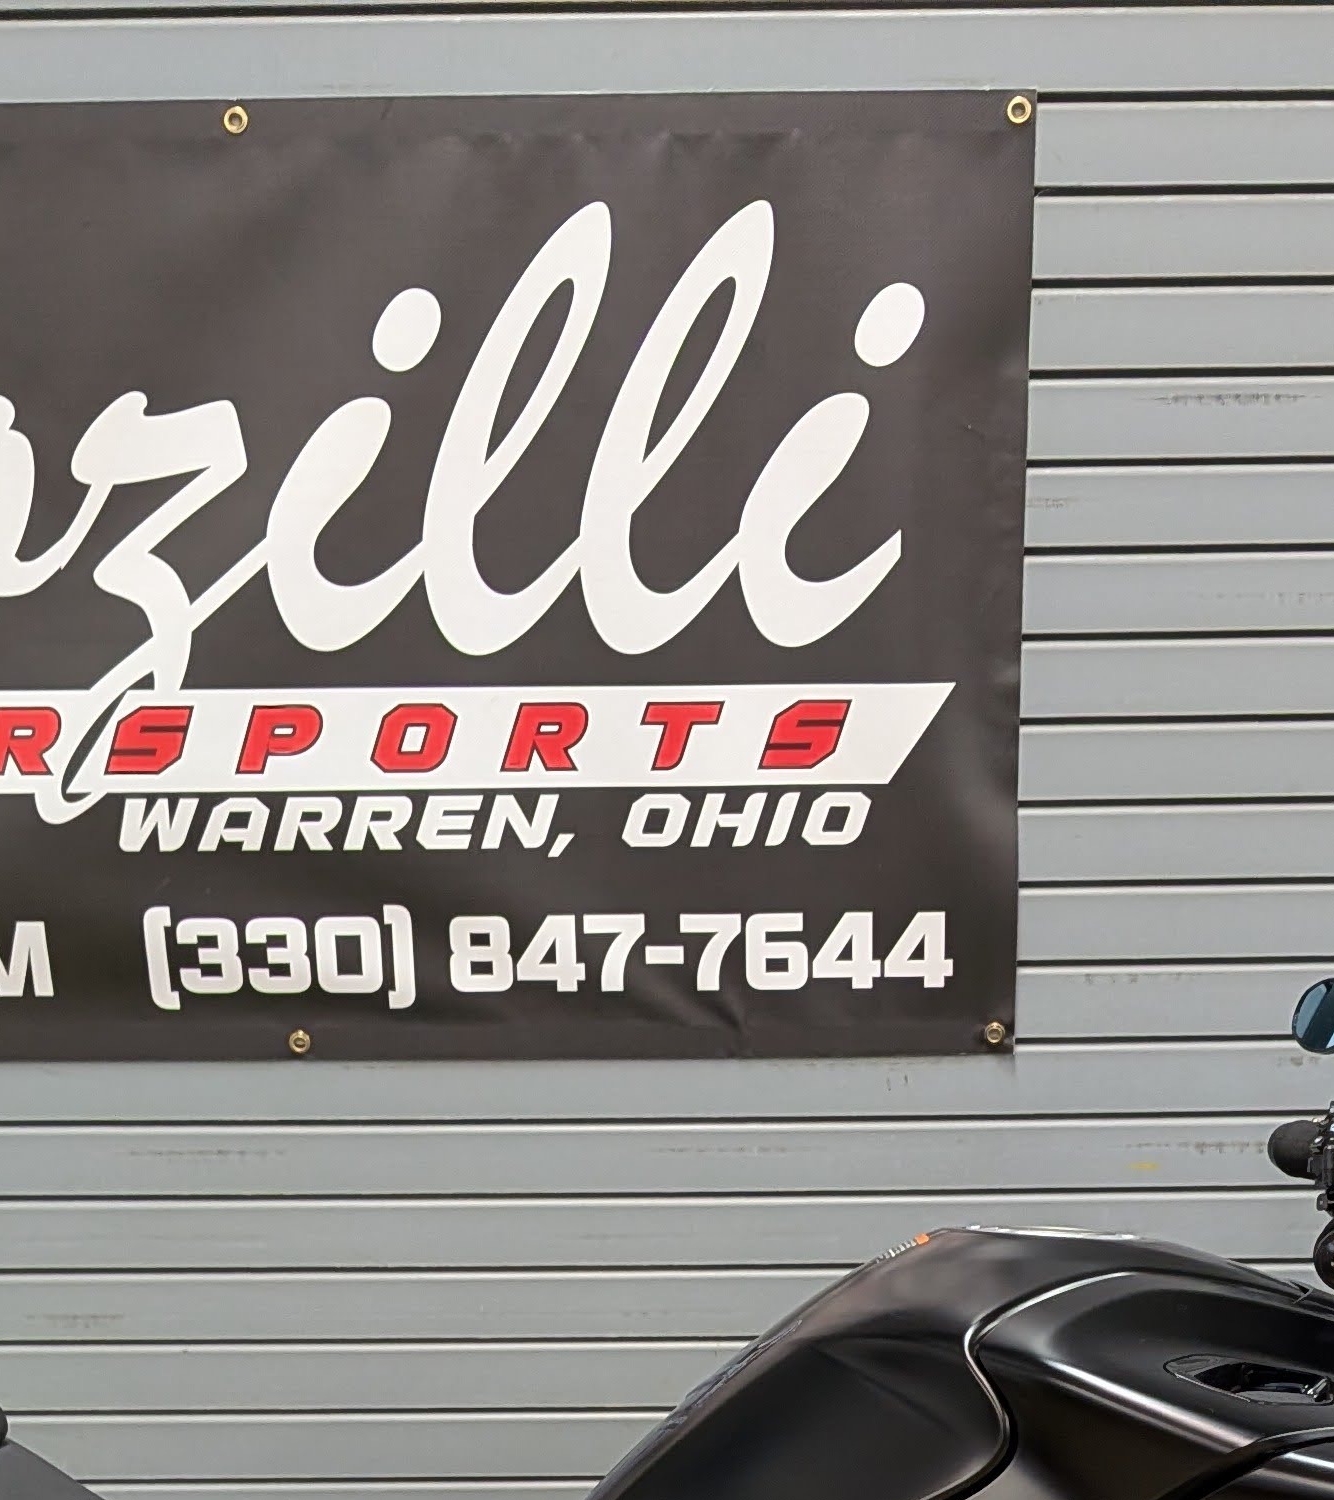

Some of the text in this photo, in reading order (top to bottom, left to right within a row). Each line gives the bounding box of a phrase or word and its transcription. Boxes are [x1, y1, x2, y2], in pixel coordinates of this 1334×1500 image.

[117, 791, 871, 858] WARREN, OHIO
[144, 904, 416, 1012] (330)
[449, 910, 954, 993] 847-7644
